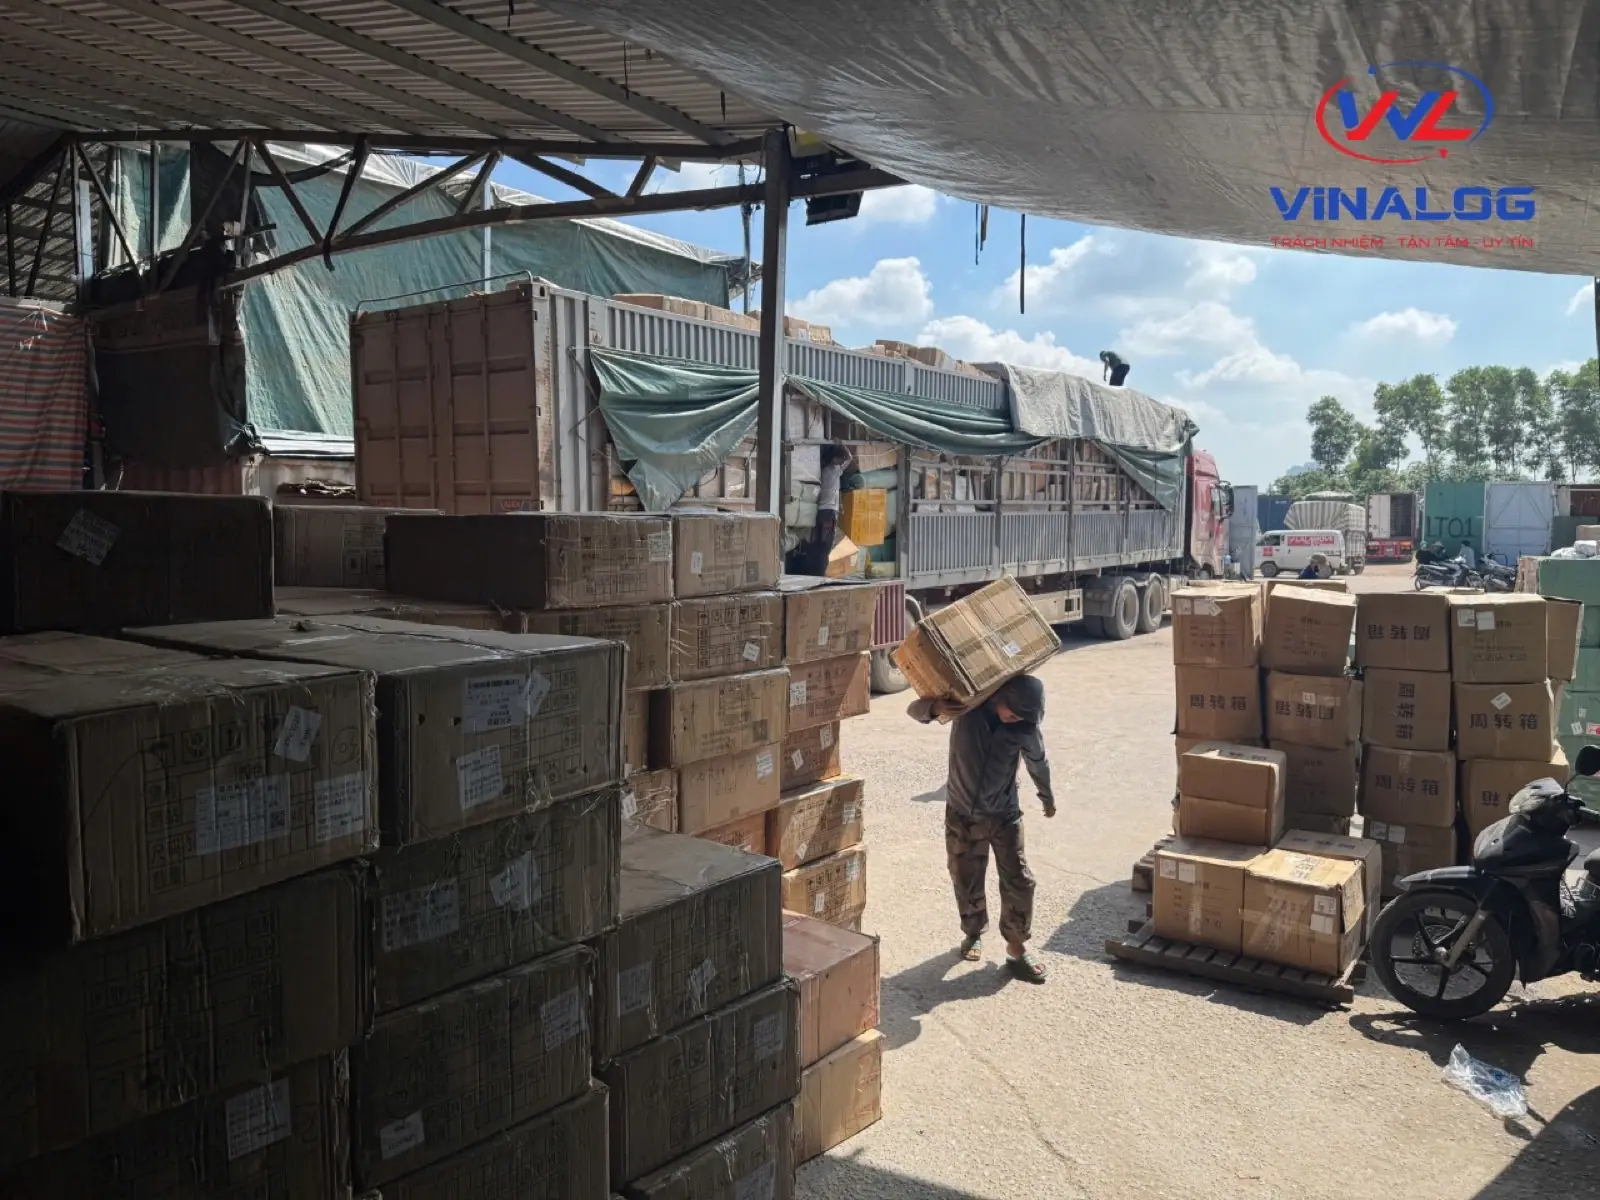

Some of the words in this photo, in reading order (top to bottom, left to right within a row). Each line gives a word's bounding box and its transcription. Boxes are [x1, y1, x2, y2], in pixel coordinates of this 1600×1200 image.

[1368, 624, 1430, 640] 周转箱
[1190, 694, 1246, 711] 周转箱
[1396, 682, 1415, 741] 周转箱
[1470, 713, 1538, 730] 周转箱
[1375, 774, 1440, 796] 周转箱
